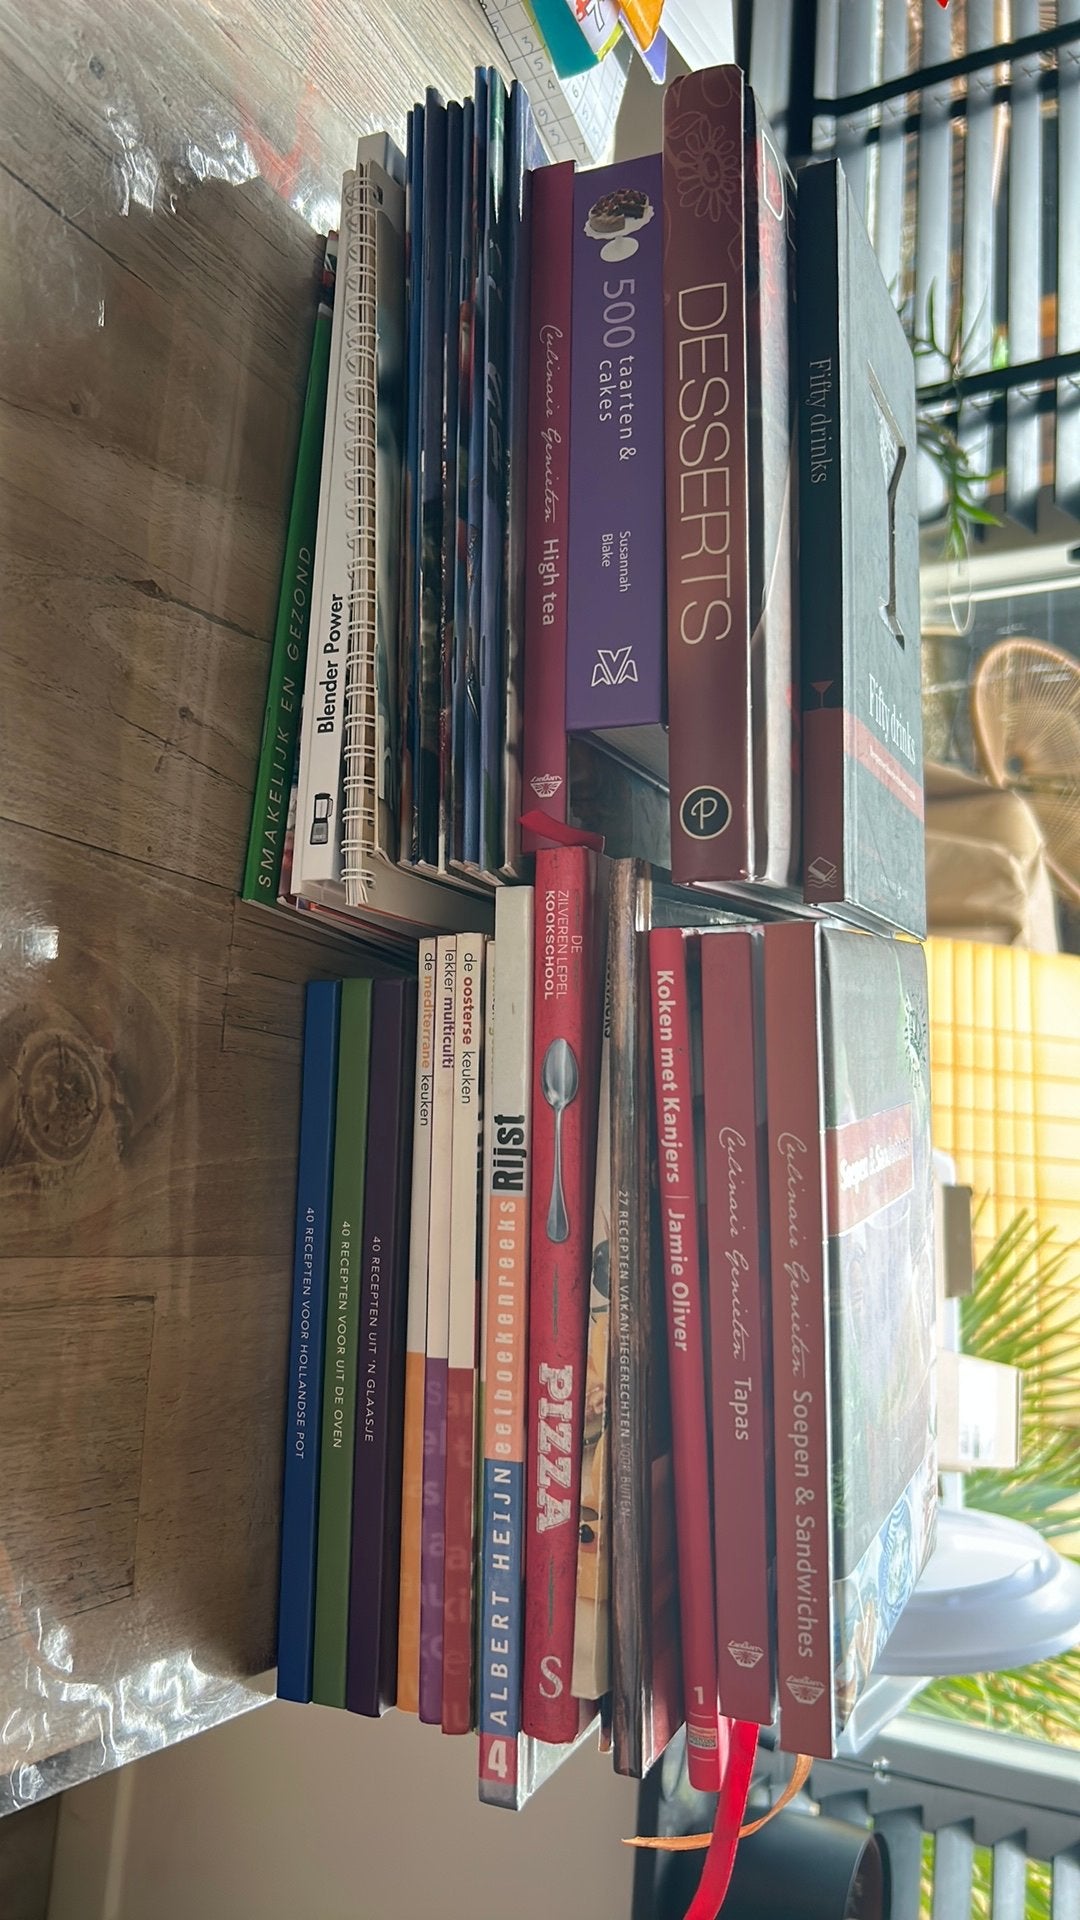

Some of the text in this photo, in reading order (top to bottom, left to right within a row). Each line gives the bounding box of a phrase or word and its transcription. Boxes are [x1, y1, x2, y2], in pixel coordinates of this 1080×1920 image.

[602, 278, 636, 349] 500
[598, 360, 616, 422] cakes
[618, 355, 636, 461] taarten &
[806, 358, 833, 484] Fifty drinks
[537, 325, 563, 626] Culinair Genieten High tea
[678, 282, 732, 645] DESSERTS
[600, 533, 614, 568] Blake
[618, 530, 633, 593] Susannah
[257, 546, 312, 889] SMAKELIJK EN GEZOND
[316, 594, 345, 734] Blender Power
[543, 889, 555, 1000] KOOKSCHOOL
[556, 889, 569, 999] ZILVEREN LEPEL
[571, 934, 583, 953] DE
[419, 953, 435, 1126] de mediterrane keuken
[442, 950, 456, 1068] lekker multiculti
[461, 953, 477, 1104] de oosterse keuken
[492, 1114, 527, 1192] Rijst
[656, 969, 691, 1352] Koken met Kanjers Jamie Oliver
[367, 1256, 380, 1327] RECEPTEN
[370, 1236, 381, 1253] 40
[718, 1127, 752, 1441] Culinair Genieten Tapas
[294, 1207, 316, 1460] 40 RECEPTEN VOOR HOLLANDSE POT
[332, 1221, 352, 1449] 40 RECEPTEN VOOR UIT DE OVEN
[366, 1331, 378, 1353] UIT
[617, 1190, 632, 1517] 27 RECEPTEN VAKANTIEGERECHTEN VOOR BUITEN
[363, 1379, 376, 1443] GLAASJE
[536, 1361, 574, 1534] PIZZA
[777, 1131, 818, 1658] Culinair Genieten Soepen & Sandwiches
[491, 1466, 512, 1571] HEIJN
[488, 1591, 510, 1727] ALBERT
[487, 1738, 508, 1779] 4
